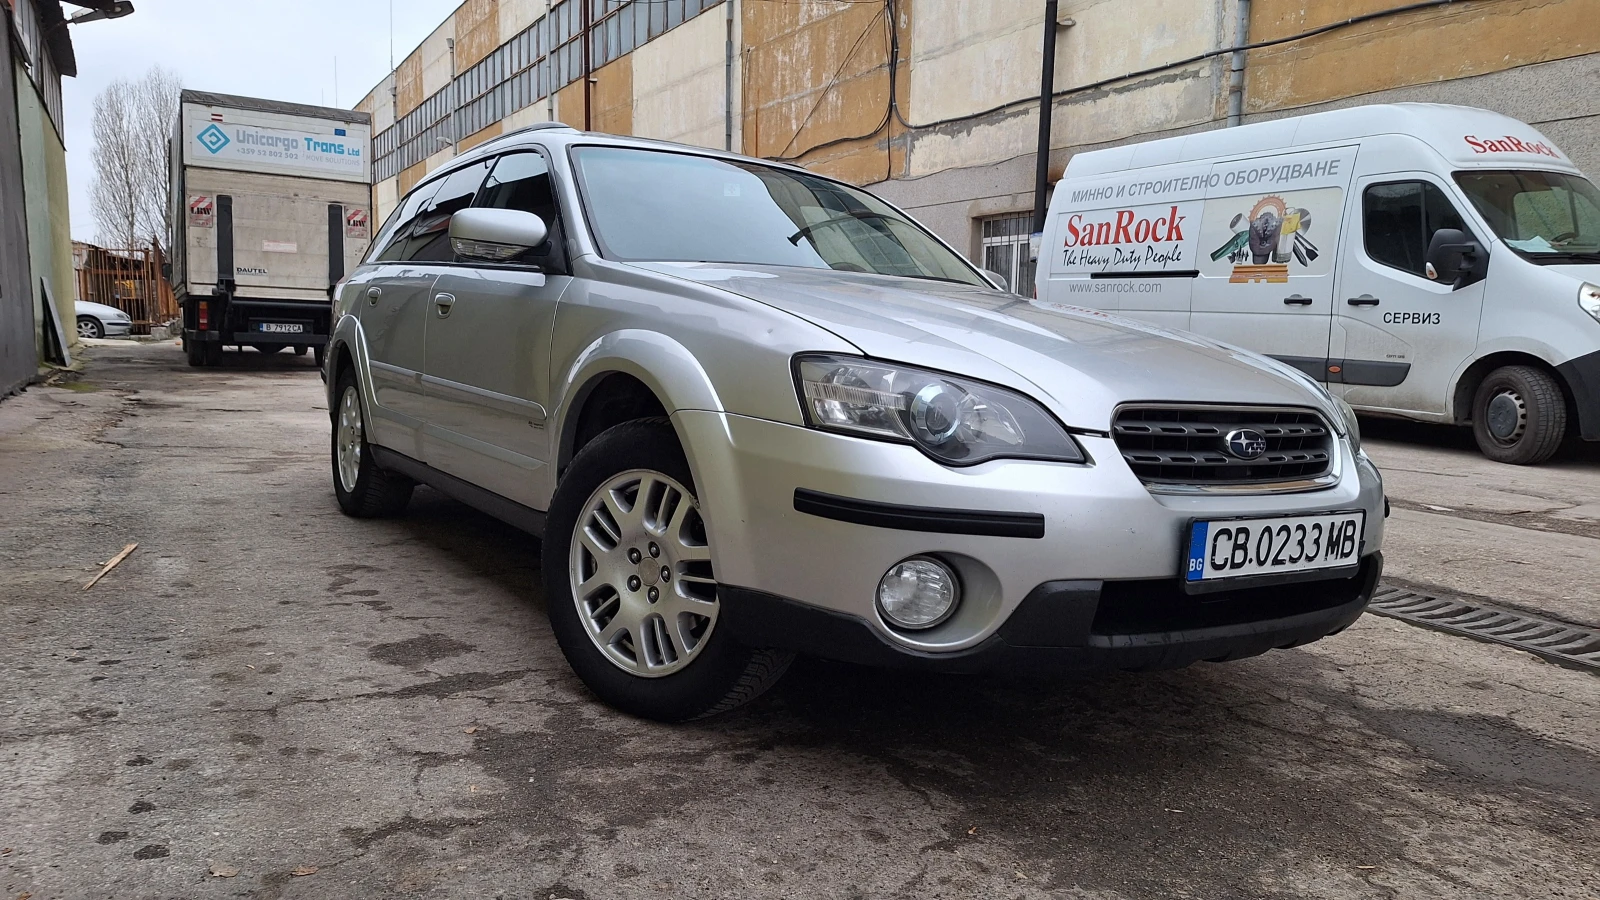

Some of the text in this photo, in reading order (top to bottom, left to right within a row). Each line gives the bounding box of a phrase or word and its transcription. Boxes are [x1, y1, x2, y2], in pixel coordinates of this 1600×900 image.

[236, 129, 360, 157] Unicargo Trans Ltd
[1464, 135, 1560, 159] SanRock
[236, 148, 255, 156] +359
[268, 150, 283, 158] 802
[284, 152, 299, 160] 502
[306, 155, 360, 166] MOVE SOLUTIONS
[1071, 160, 1341, 203] МИННО И СТРОИТЕЛНО ОБОРУДВАНЕ
[1064, 206, 1186, 248] SanRock
[1063, 244, 1182, 271] The Heavy Duty People
[1069, 281, 1162, 293] www.sanrock.com
[1383, 311, 1441, 325] СЕРВИЗ
[1189, 558, 1203, 572] BG
